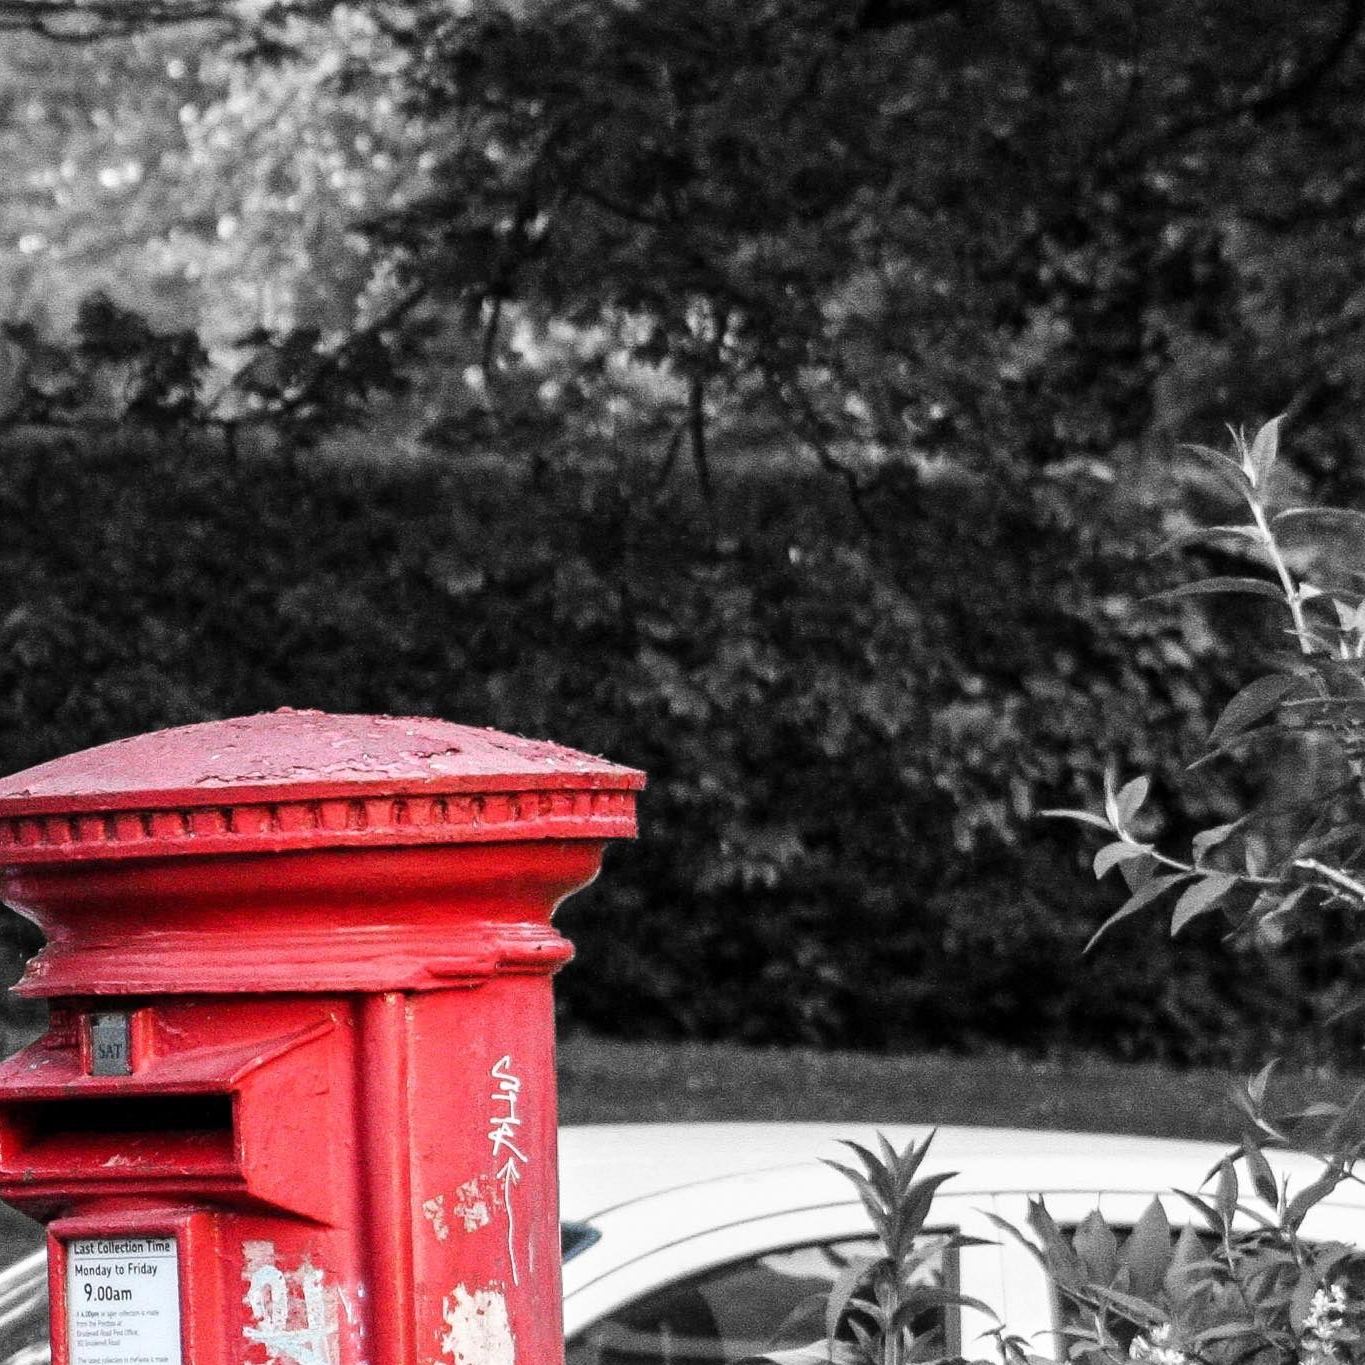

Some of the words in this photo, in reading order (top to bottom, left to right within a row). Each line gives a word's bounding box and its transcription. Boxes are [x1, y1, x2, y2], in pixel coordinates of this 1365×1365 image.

[98, 1042, 124, 1059] SAT
[74, 1242, 95, 1254] Last
[97, 1240, 144, 1254] Collection
[146, 1239, 171, 1252] Time
[75, 1264, 111, 1278] Monday
[115, 1265, 125, 1275] to
[128, 1262, 158, 1277] Friday
[83, 1283, 133, 1302] 9.00am
